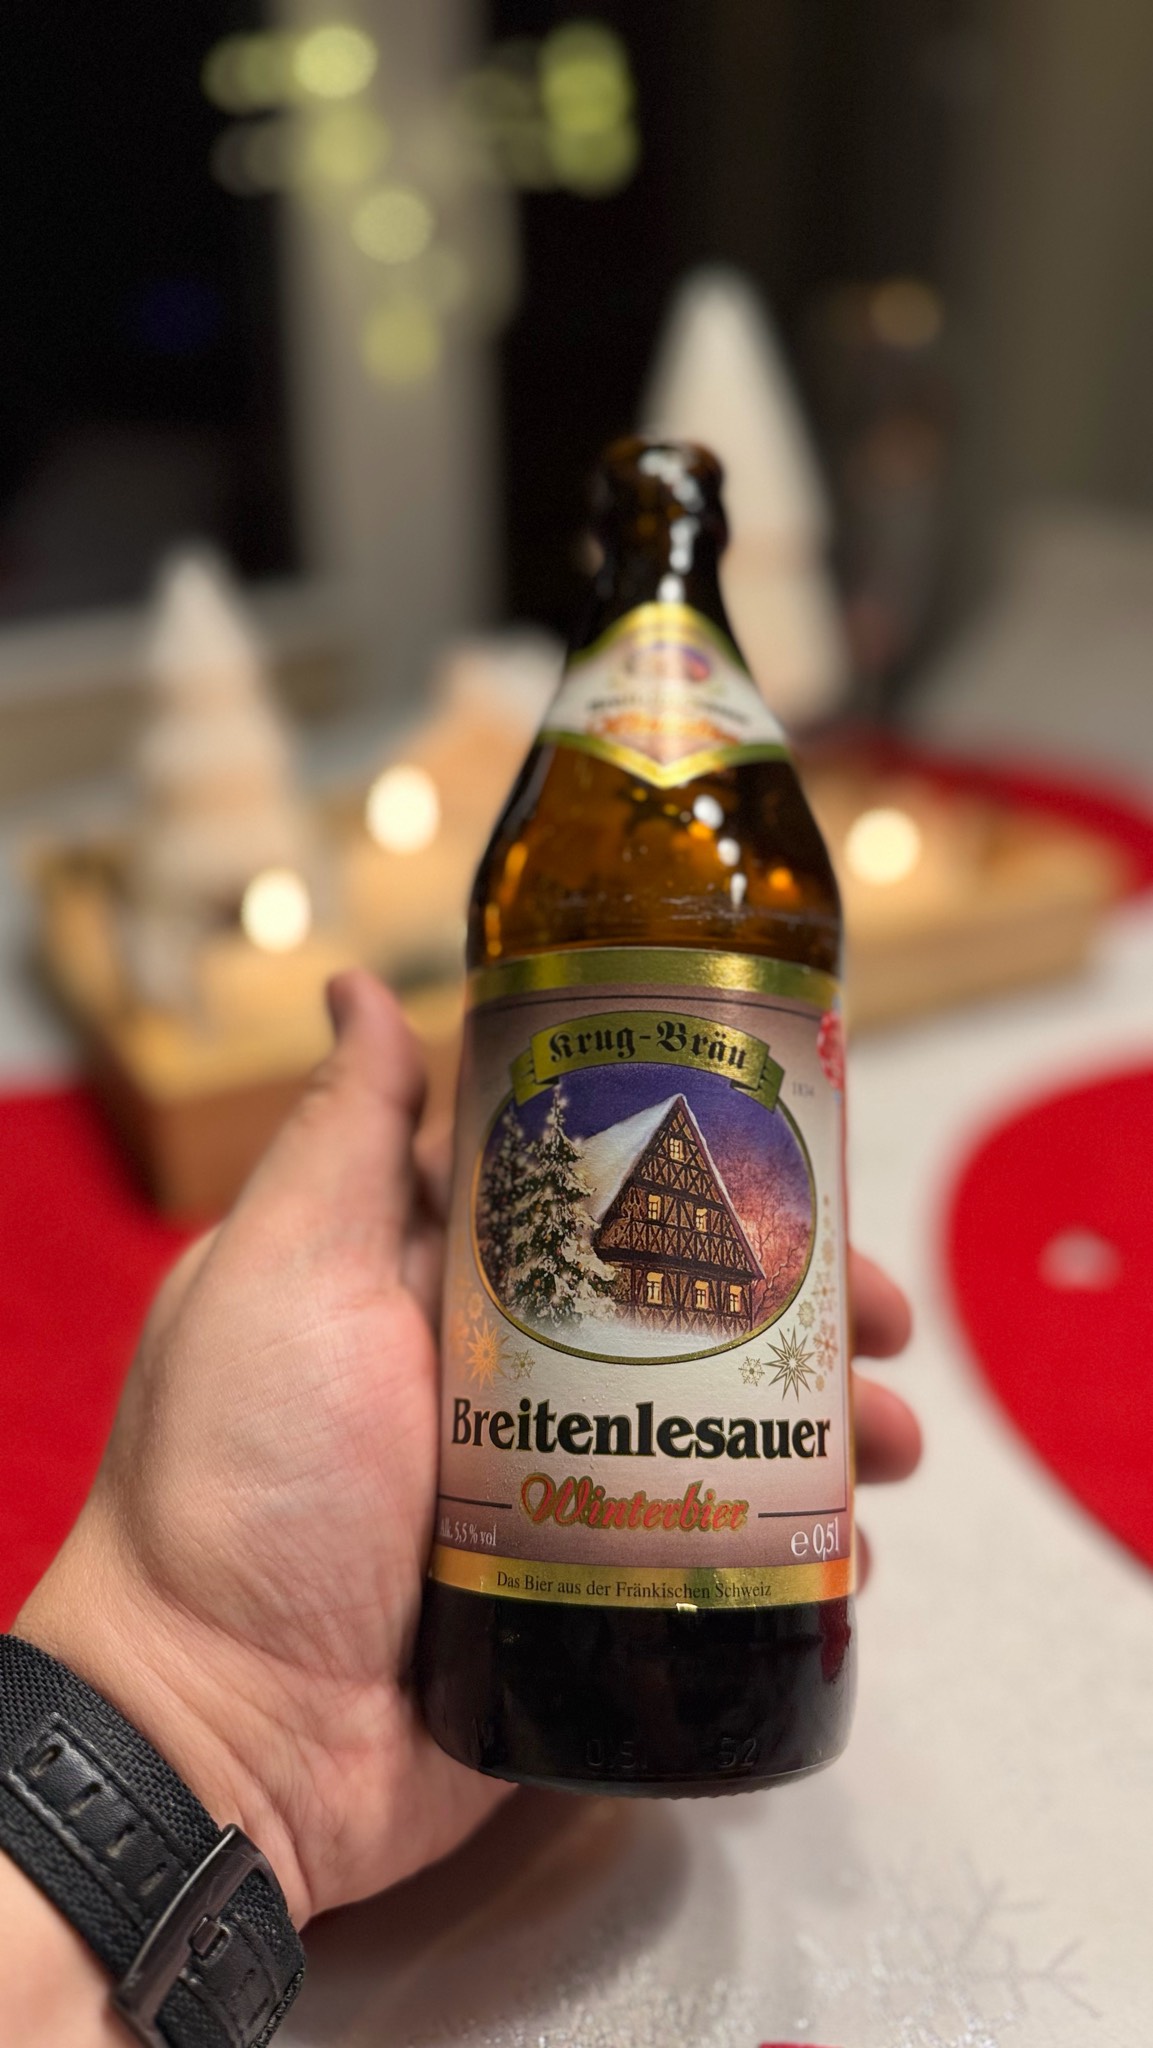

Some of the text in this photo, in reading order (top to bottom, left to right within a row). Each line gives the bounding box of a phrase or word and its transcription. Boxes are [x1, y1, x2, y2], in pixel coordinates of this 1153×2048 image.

[549, 1020, 746, 1069] Krug-Bräu
[452, 1397, 831, 1459] Breitenlesauer
[519, 1472, 749, 1532] Winterbier
[454, 1521, 467, 1544] 5,5
[480, 1522, 497, 1546] vol
[497, 1571, 772, 1599] Das Bier aus der Fränkischen Schweiz
